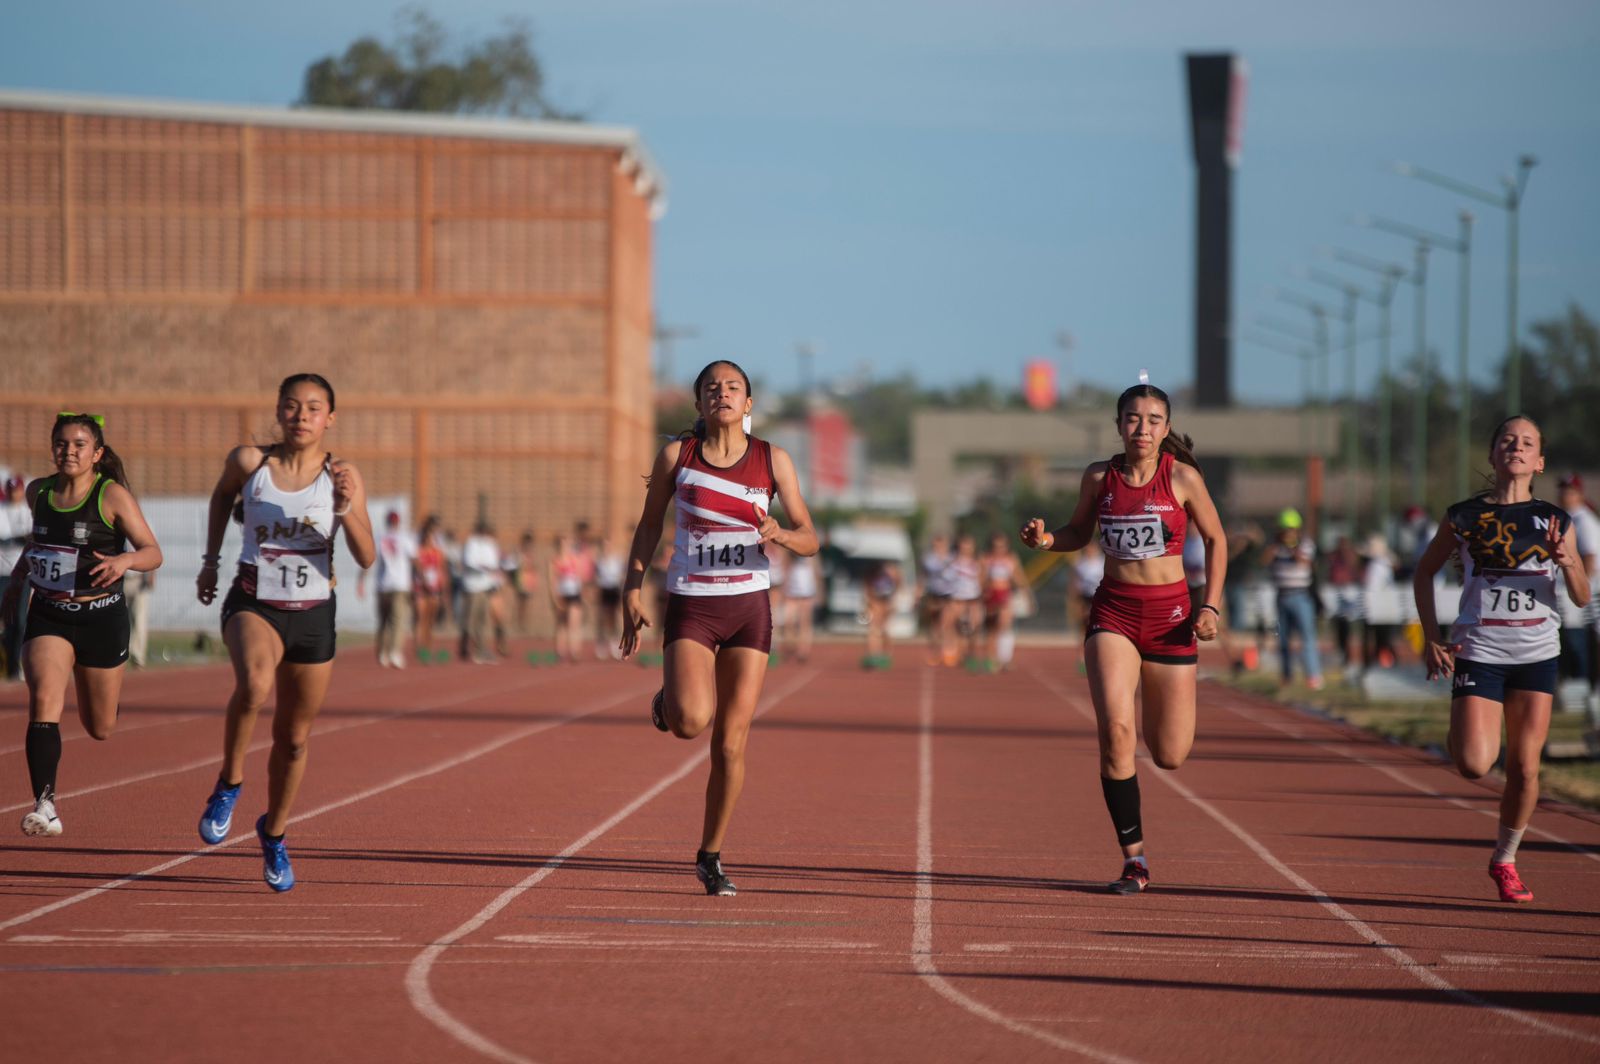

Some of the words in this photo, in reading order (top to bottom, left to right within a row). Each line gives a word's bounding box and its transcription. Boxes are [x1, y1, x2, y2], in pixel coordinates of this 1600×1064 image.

[254, 515, 319, 544] BAJA
[1101, 526, 1156, 550] 1732
[695, 543, 745, 567] 1143
[32, 556, 61, 583] 565
[278, 565, 308, 588] 15
[88, 592, 122, 610] NIKE
[1490, 588, 1536, 612] 763
[1454, 673, 1476, 689] NL
